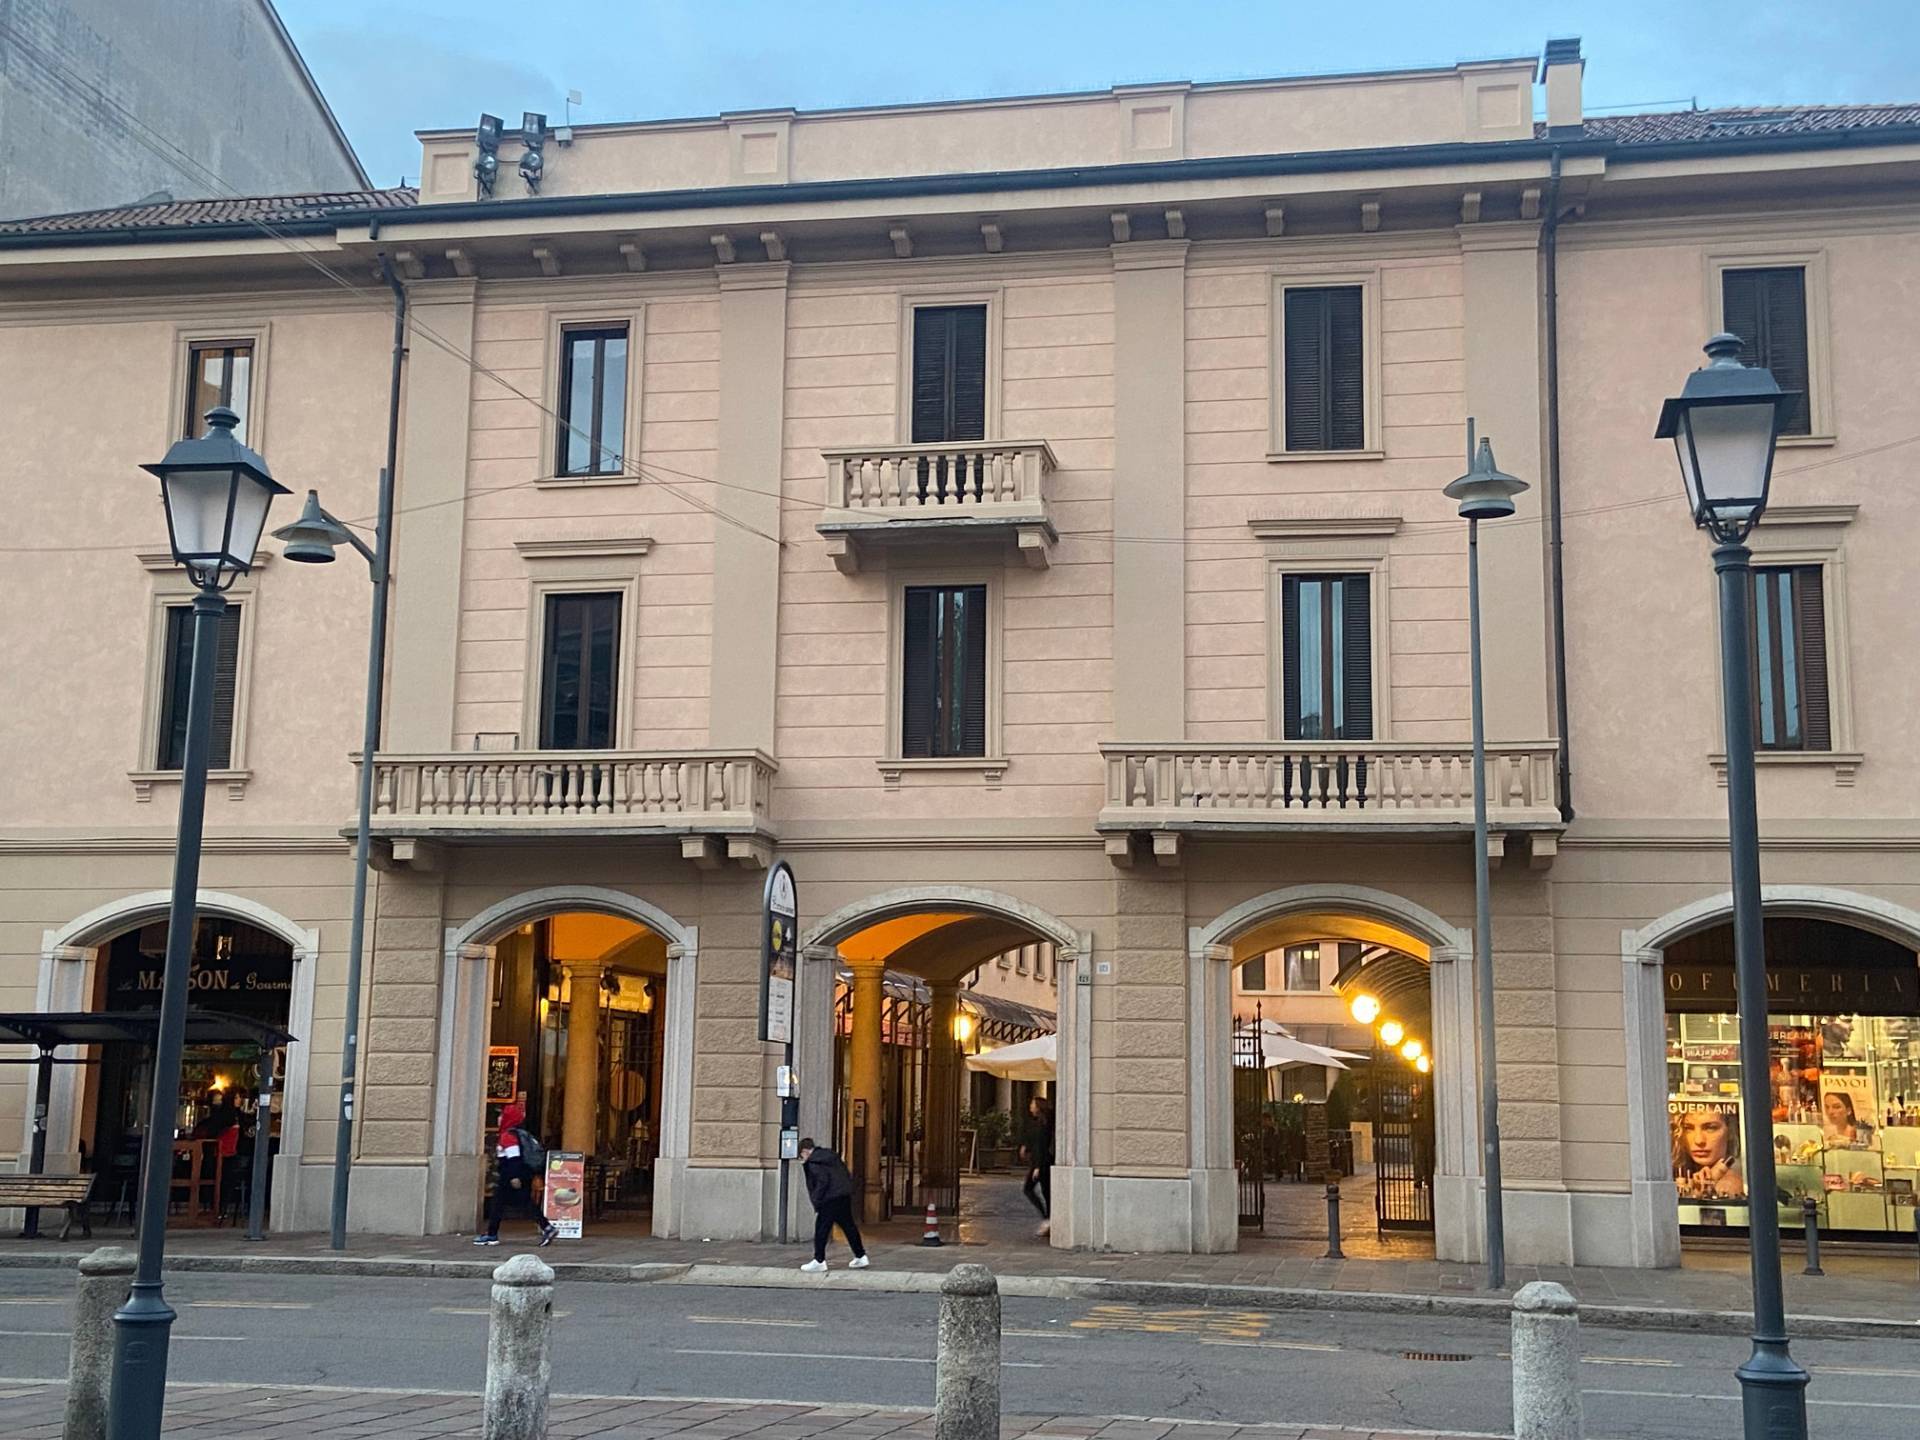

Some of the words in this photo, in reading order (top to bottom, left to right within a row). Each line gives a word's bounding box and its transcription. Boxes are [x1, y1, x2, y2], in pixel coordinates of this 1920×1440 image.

[137, 969, 230, 991] MSON
[1823, 1077, 1869, 1088] PAYOT
[1667, 1102, 1737, 1114] GUERLAIN
